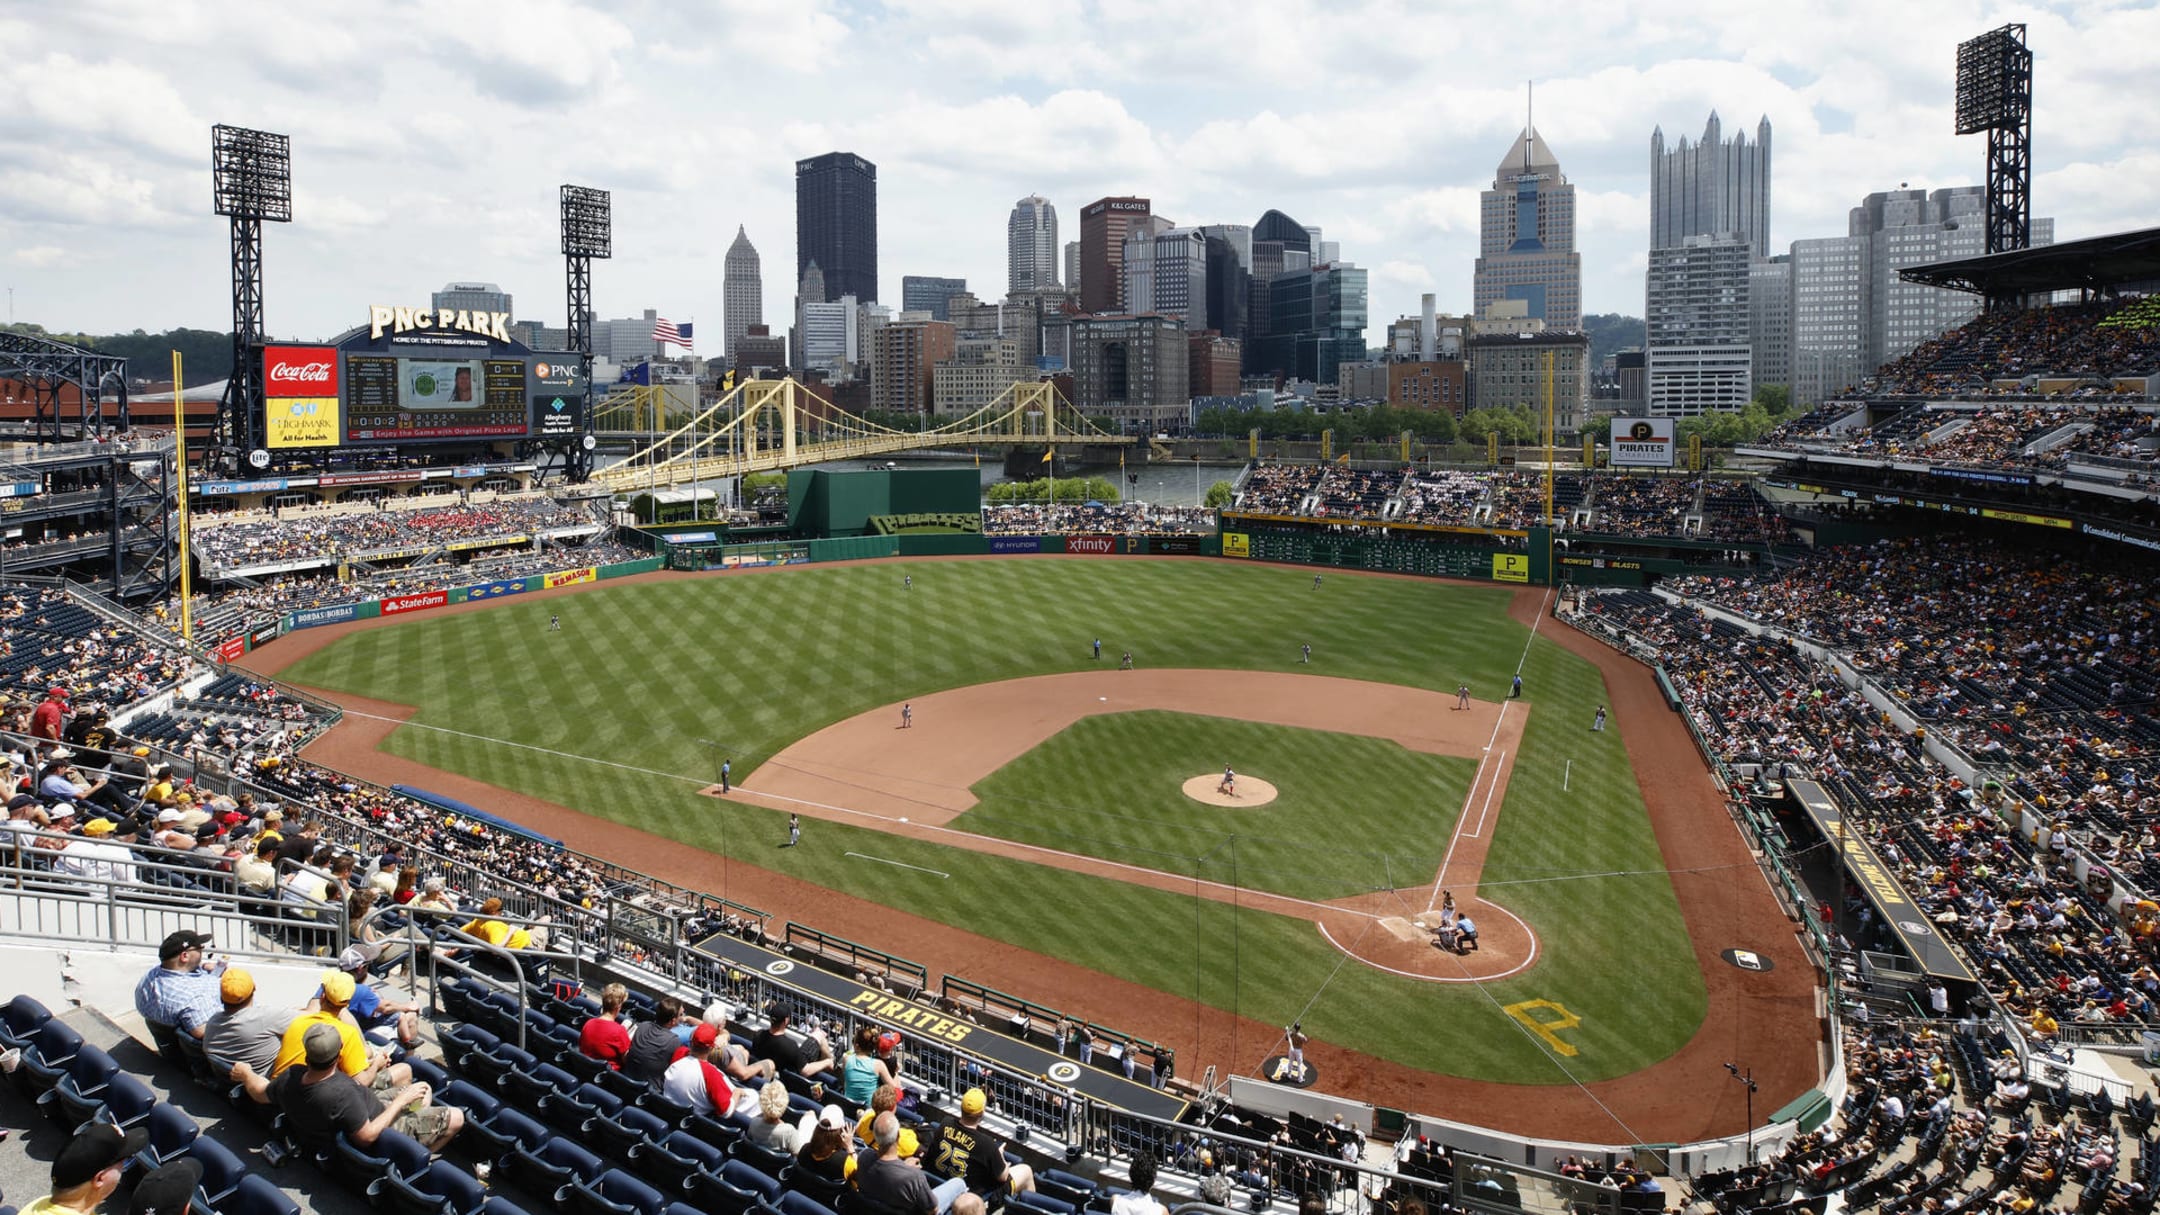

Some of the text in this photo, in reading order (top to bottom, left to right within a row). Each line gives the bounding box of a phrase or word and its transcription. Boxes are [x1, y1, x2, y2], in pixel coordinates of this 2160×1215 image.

[369, 304, 512, 344] PNC PARK
[551, 365, 579, 377] PNC
[376, 430, 397, 438] Enjoy
[454, 427, 482, 436] Original
[1619, 444, 1665, 453] PIRATES
[252, 453, 268, 463] Lite
[1069, 538, 1112, 553] xfinity
[1127, 539, 1137, 553] P
[1506, 557, 1517, 569] P
[1562, 557, 1593, 566] BOWSER
[1611, 562, 1640, 570] BLASTS
[298, 607, 353, 623] BORDAS BORDAS
[850, 989, 974, 1042] PIRATES
[1502, 998, 1582, 1056] P
[943, 1126, 976, 1151] POLANCO
[935, 1139, 970, 1178] 25
